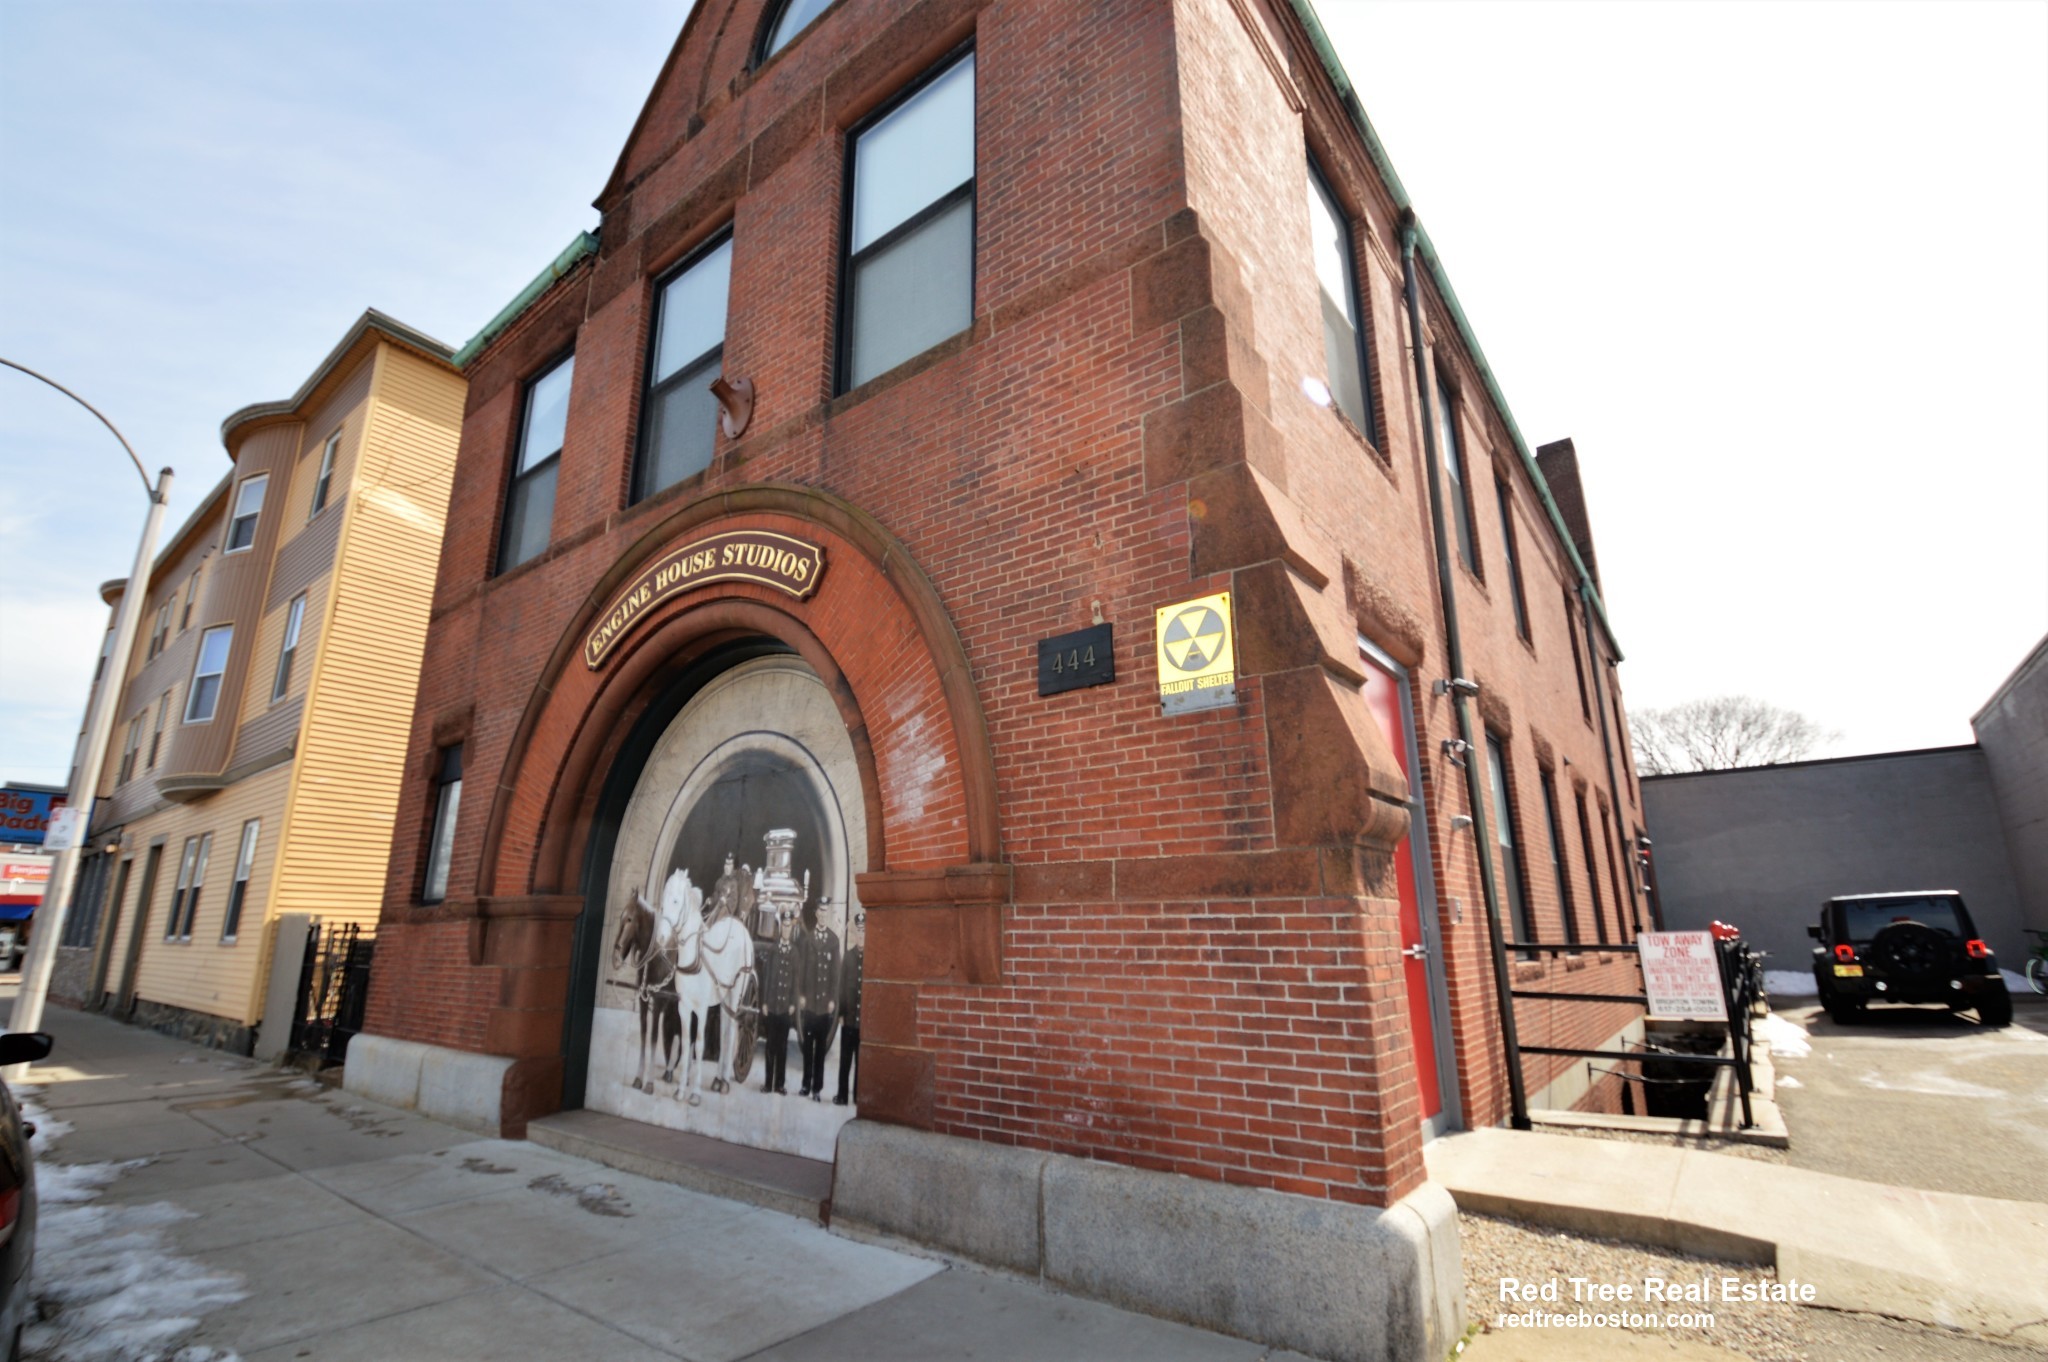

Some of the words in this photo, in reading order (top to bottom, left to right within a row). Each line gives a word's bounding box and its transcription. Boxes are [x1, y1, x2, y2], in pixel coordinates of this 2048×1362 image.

[590, 582, 651, 655] ENGINE
[655, 548, 717, 592] HOUSE
[721, 543, 811, 582] STUDIOS
[1053, 645, 1096, 674] 444
[1160, 679, 1195, 696] FALLOUT
[1197, 671, 1235, 690] SHELTER
[1646, 935, 1671, 947] TOW
[1674, 934, 1704, 945] AWAY
[1663, 946, 1692, 958] ZONE
